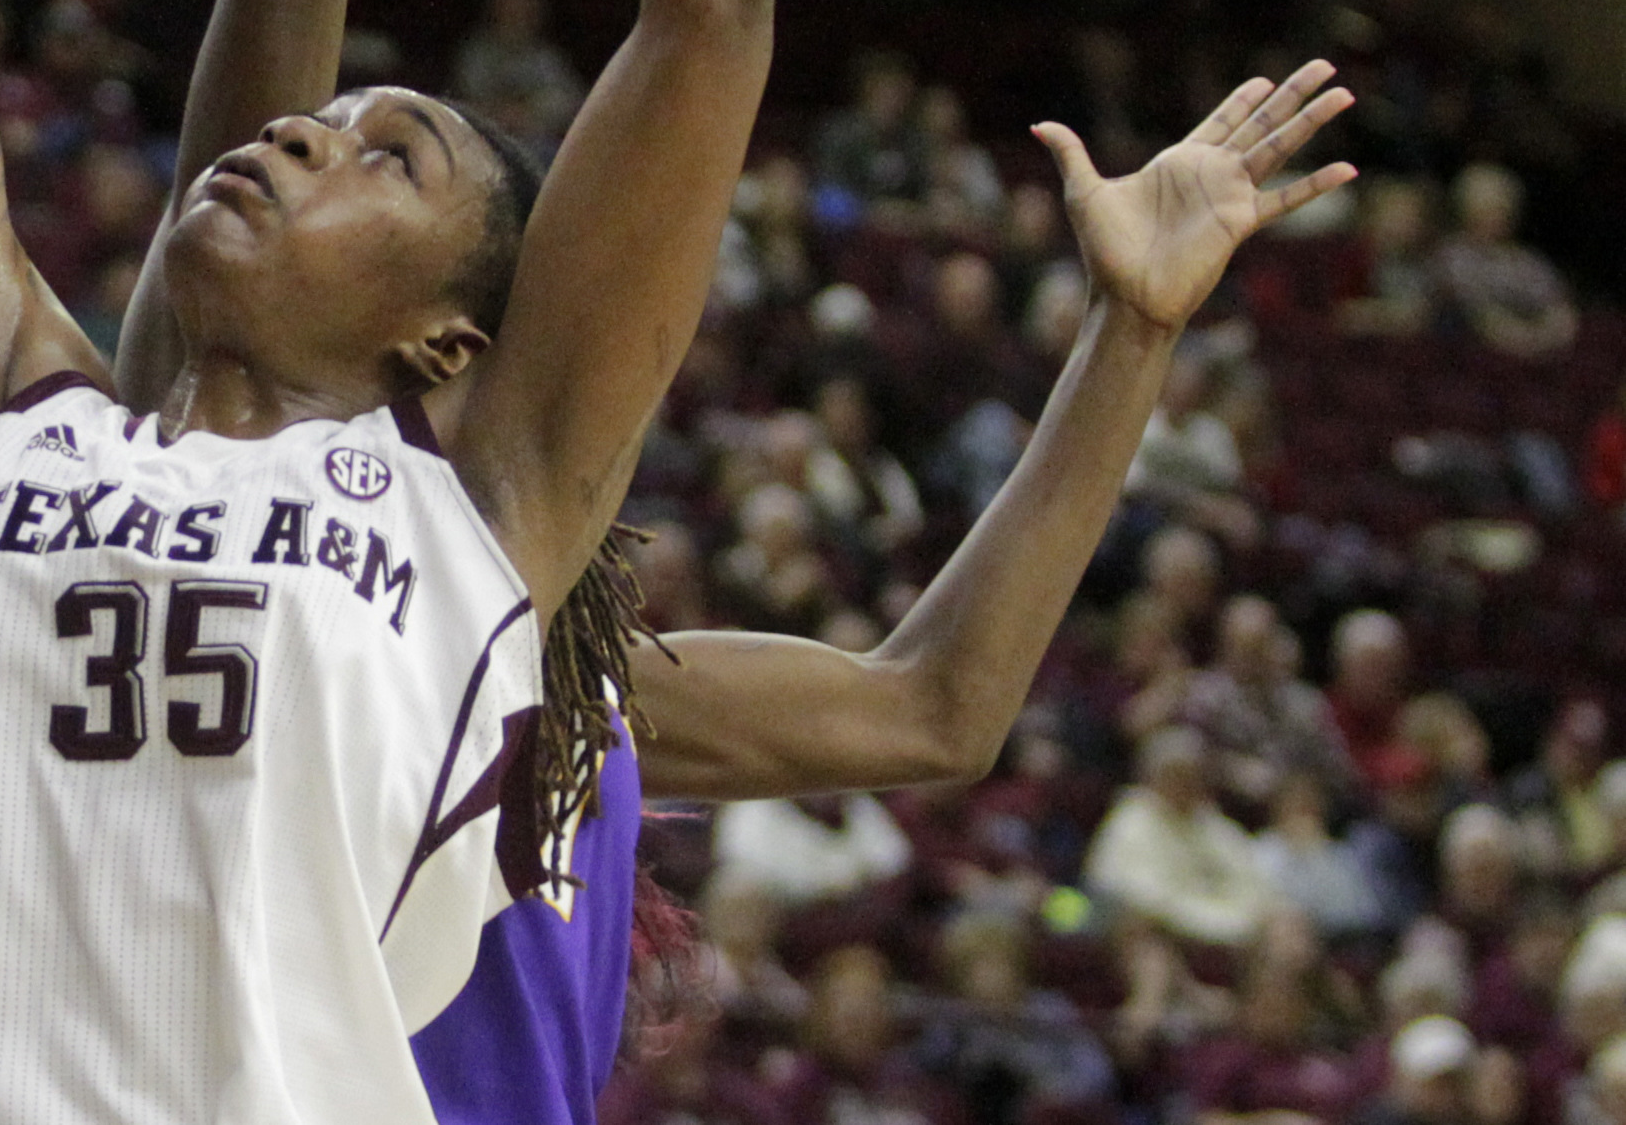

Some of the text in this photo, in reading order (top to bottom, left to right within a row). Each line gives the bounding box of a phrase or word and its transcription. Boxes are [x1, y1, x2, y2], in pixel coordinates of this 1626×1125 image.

[330, 449, 388, 496] SEC
[251, 496, 418, 638] A&M
[49, 578, 269, 762] 35
